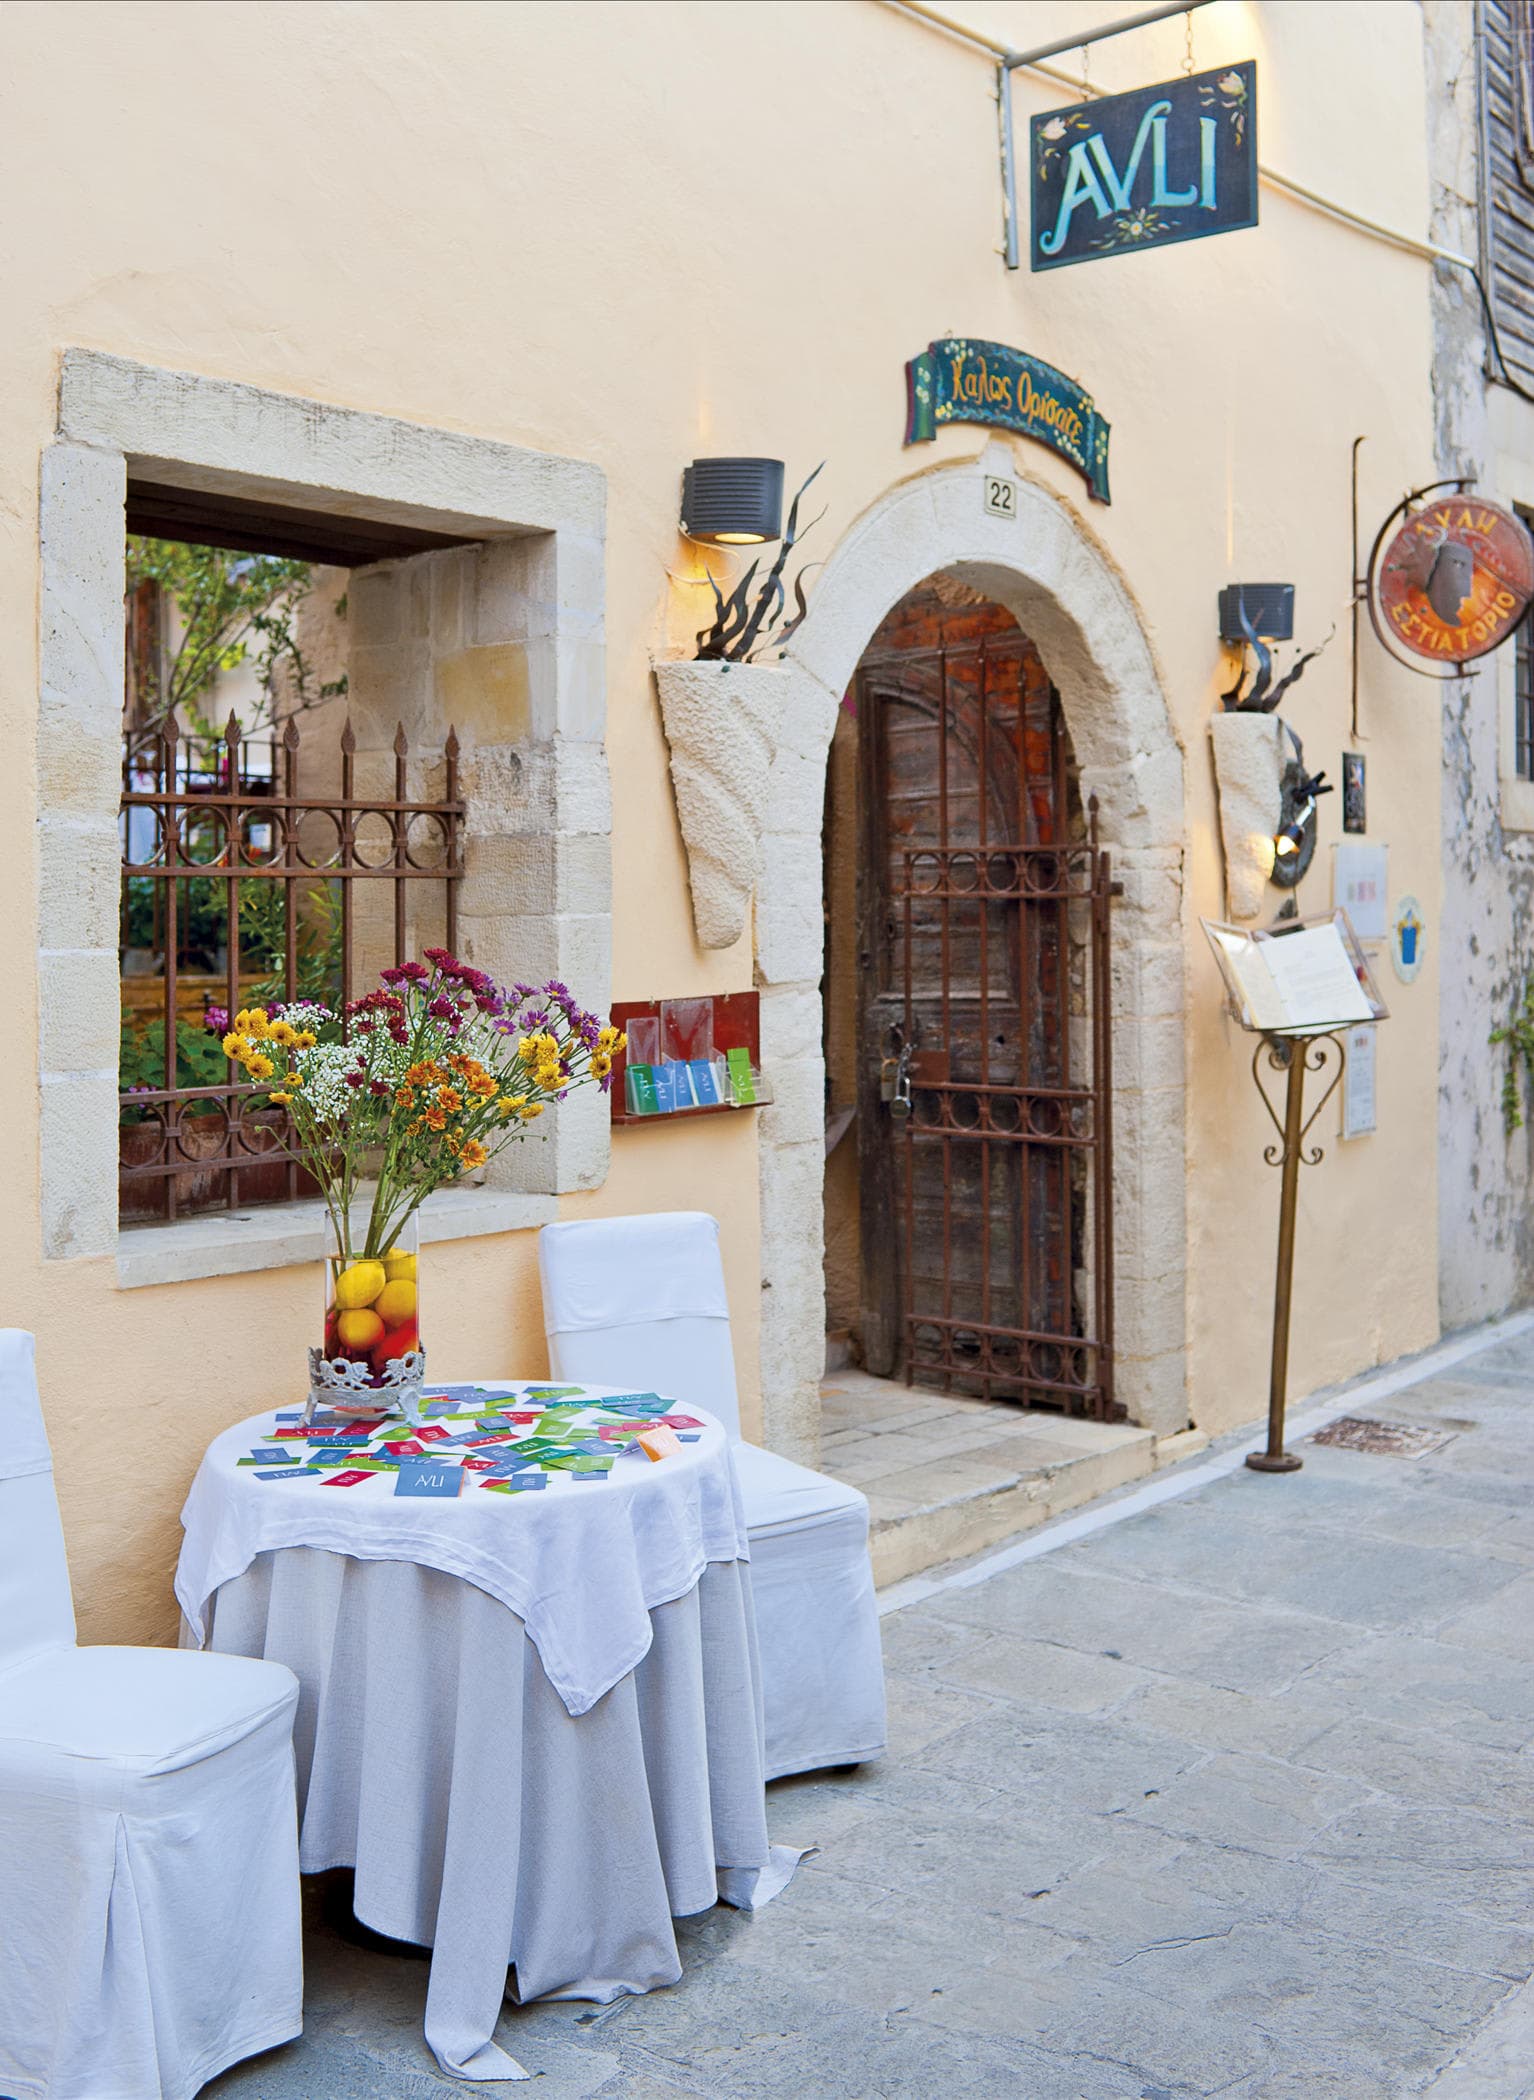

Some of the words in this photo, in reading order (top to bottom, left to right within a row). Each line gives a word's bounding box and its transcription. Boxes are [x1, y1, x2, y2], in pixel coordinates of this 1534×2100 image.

[1039, 99, 1217, 255] AVLI
[990, 481, 1012, 510] 22
[414, 1474, 445, 1488] AVLI
